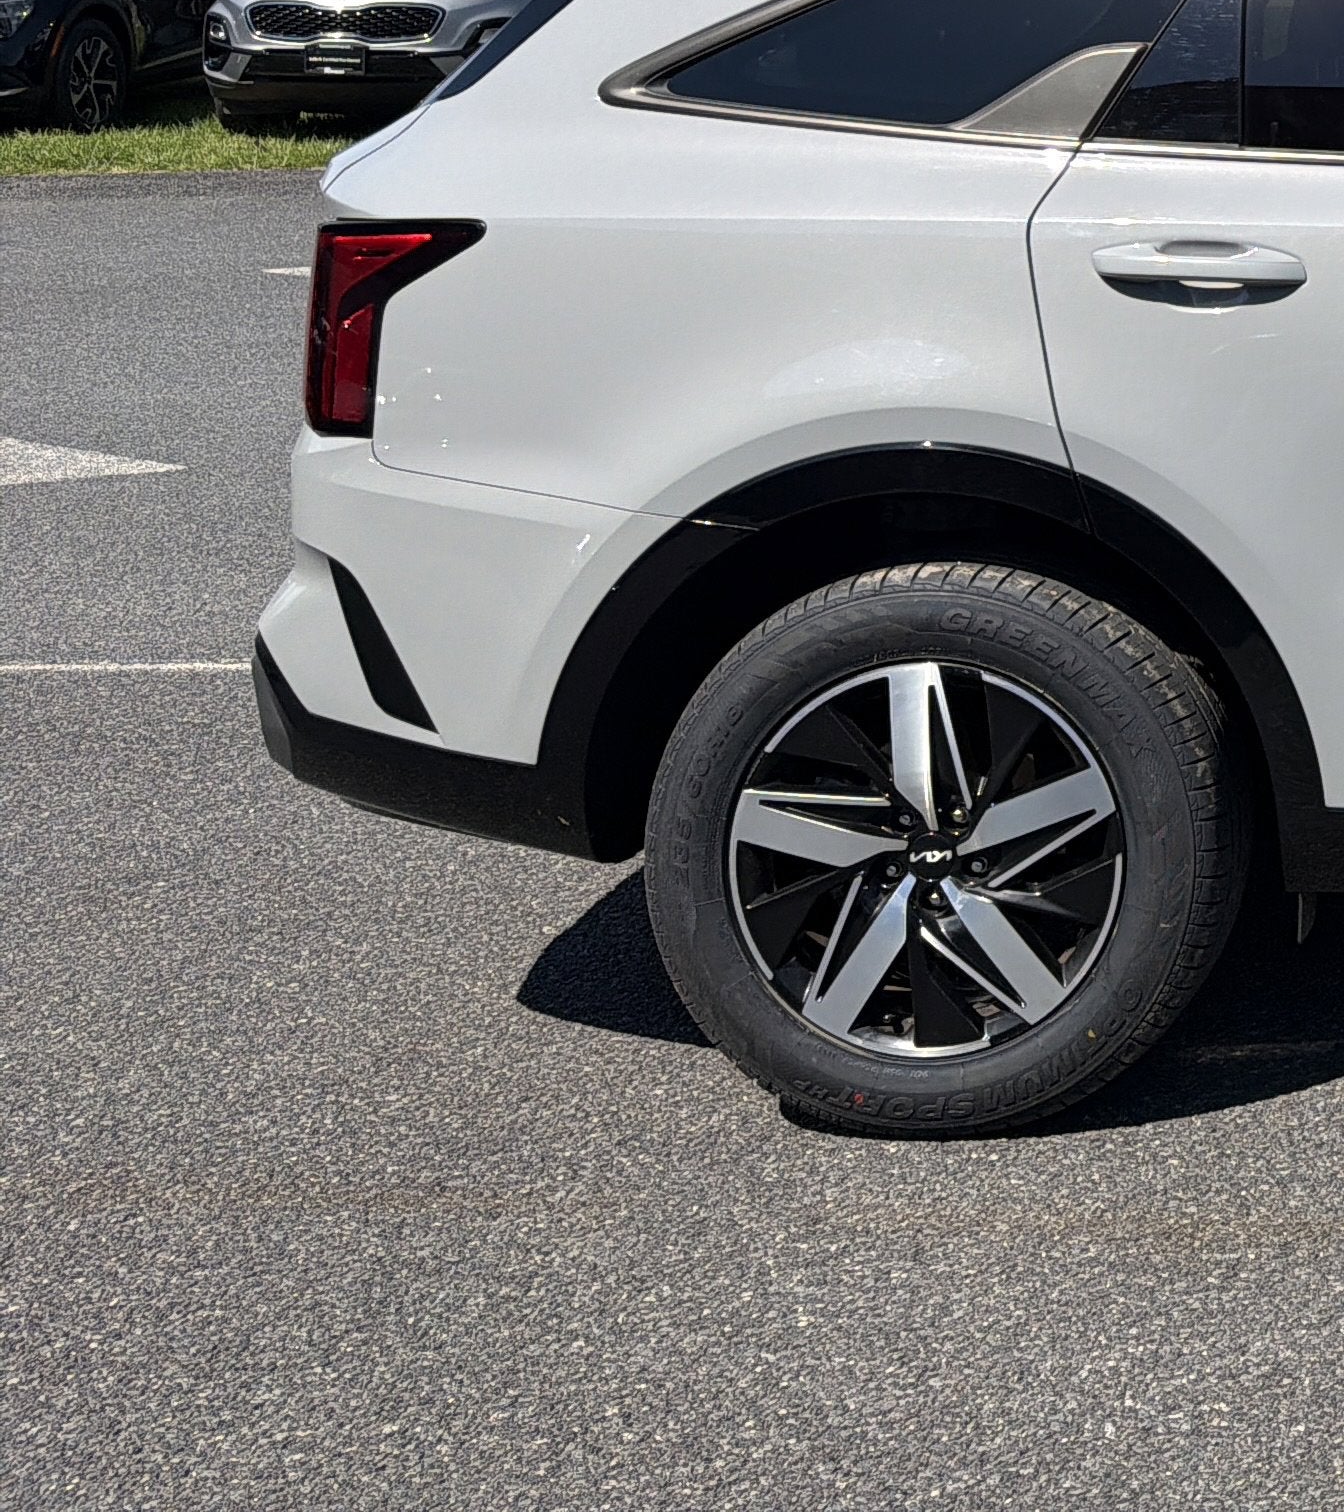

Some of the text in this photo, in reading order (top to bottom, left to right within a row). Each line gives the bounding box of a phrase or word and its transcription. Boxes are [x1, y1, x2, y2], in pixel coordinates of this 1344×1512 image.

[939, 606, 1157, 761] GREENMAX
[909, 849, 953, 863] KIA
[825, 1086, 976, 1121] SPORT
